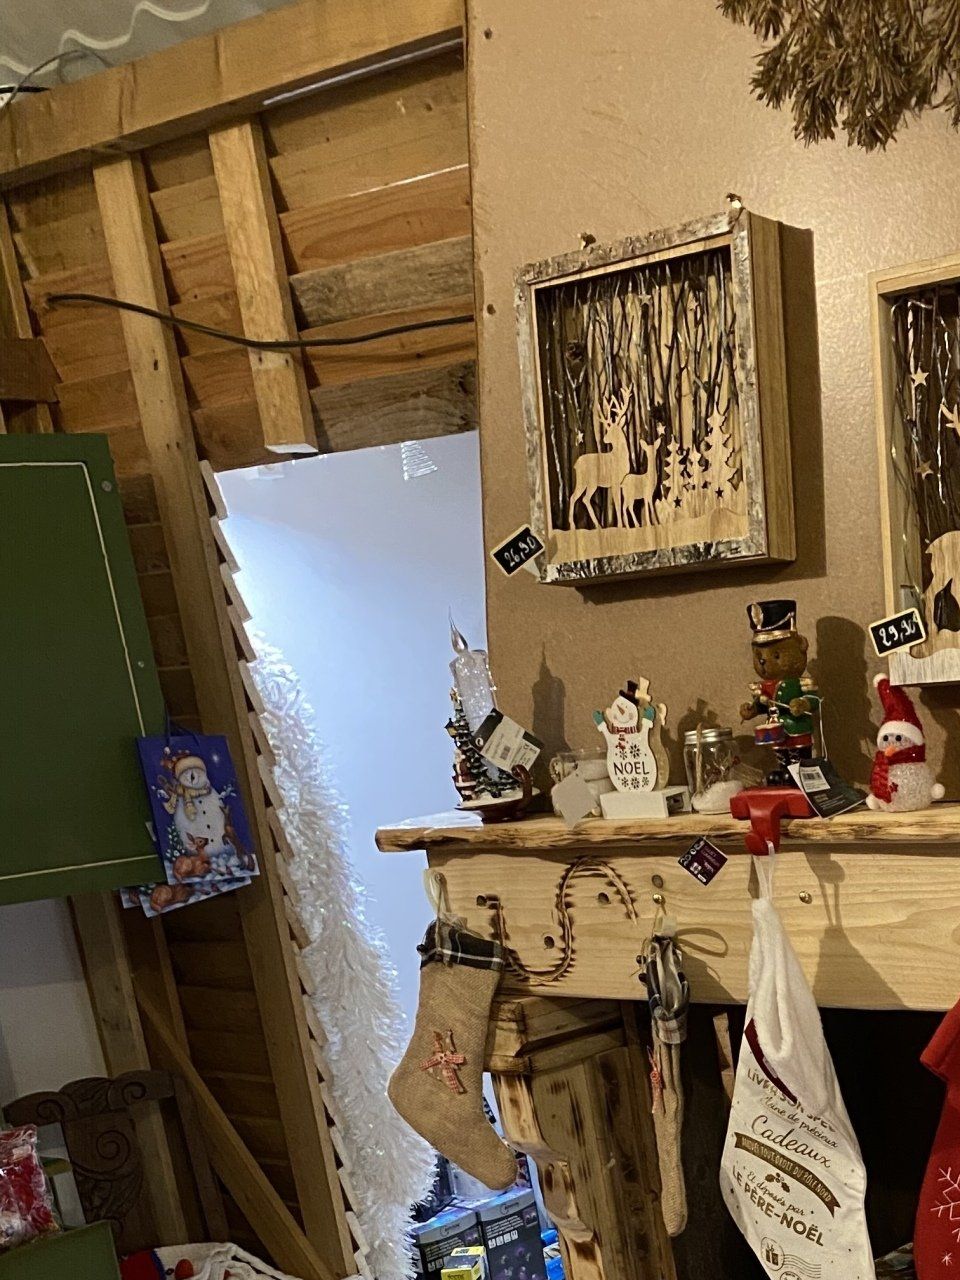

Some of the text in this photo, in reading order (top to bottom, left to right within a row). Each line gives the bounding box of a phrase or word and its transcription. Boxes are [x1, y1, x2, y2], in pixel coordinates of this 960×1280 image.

[613, 760, 650, 776] NOEL
[751, 1114, 831, 1169] Cadeaux
[799, 1121, 838, 1148] précieux
[732, 1165, 824, 1247] LE PÈRE-NOËL
[786, 1203, 806, 1216] par
